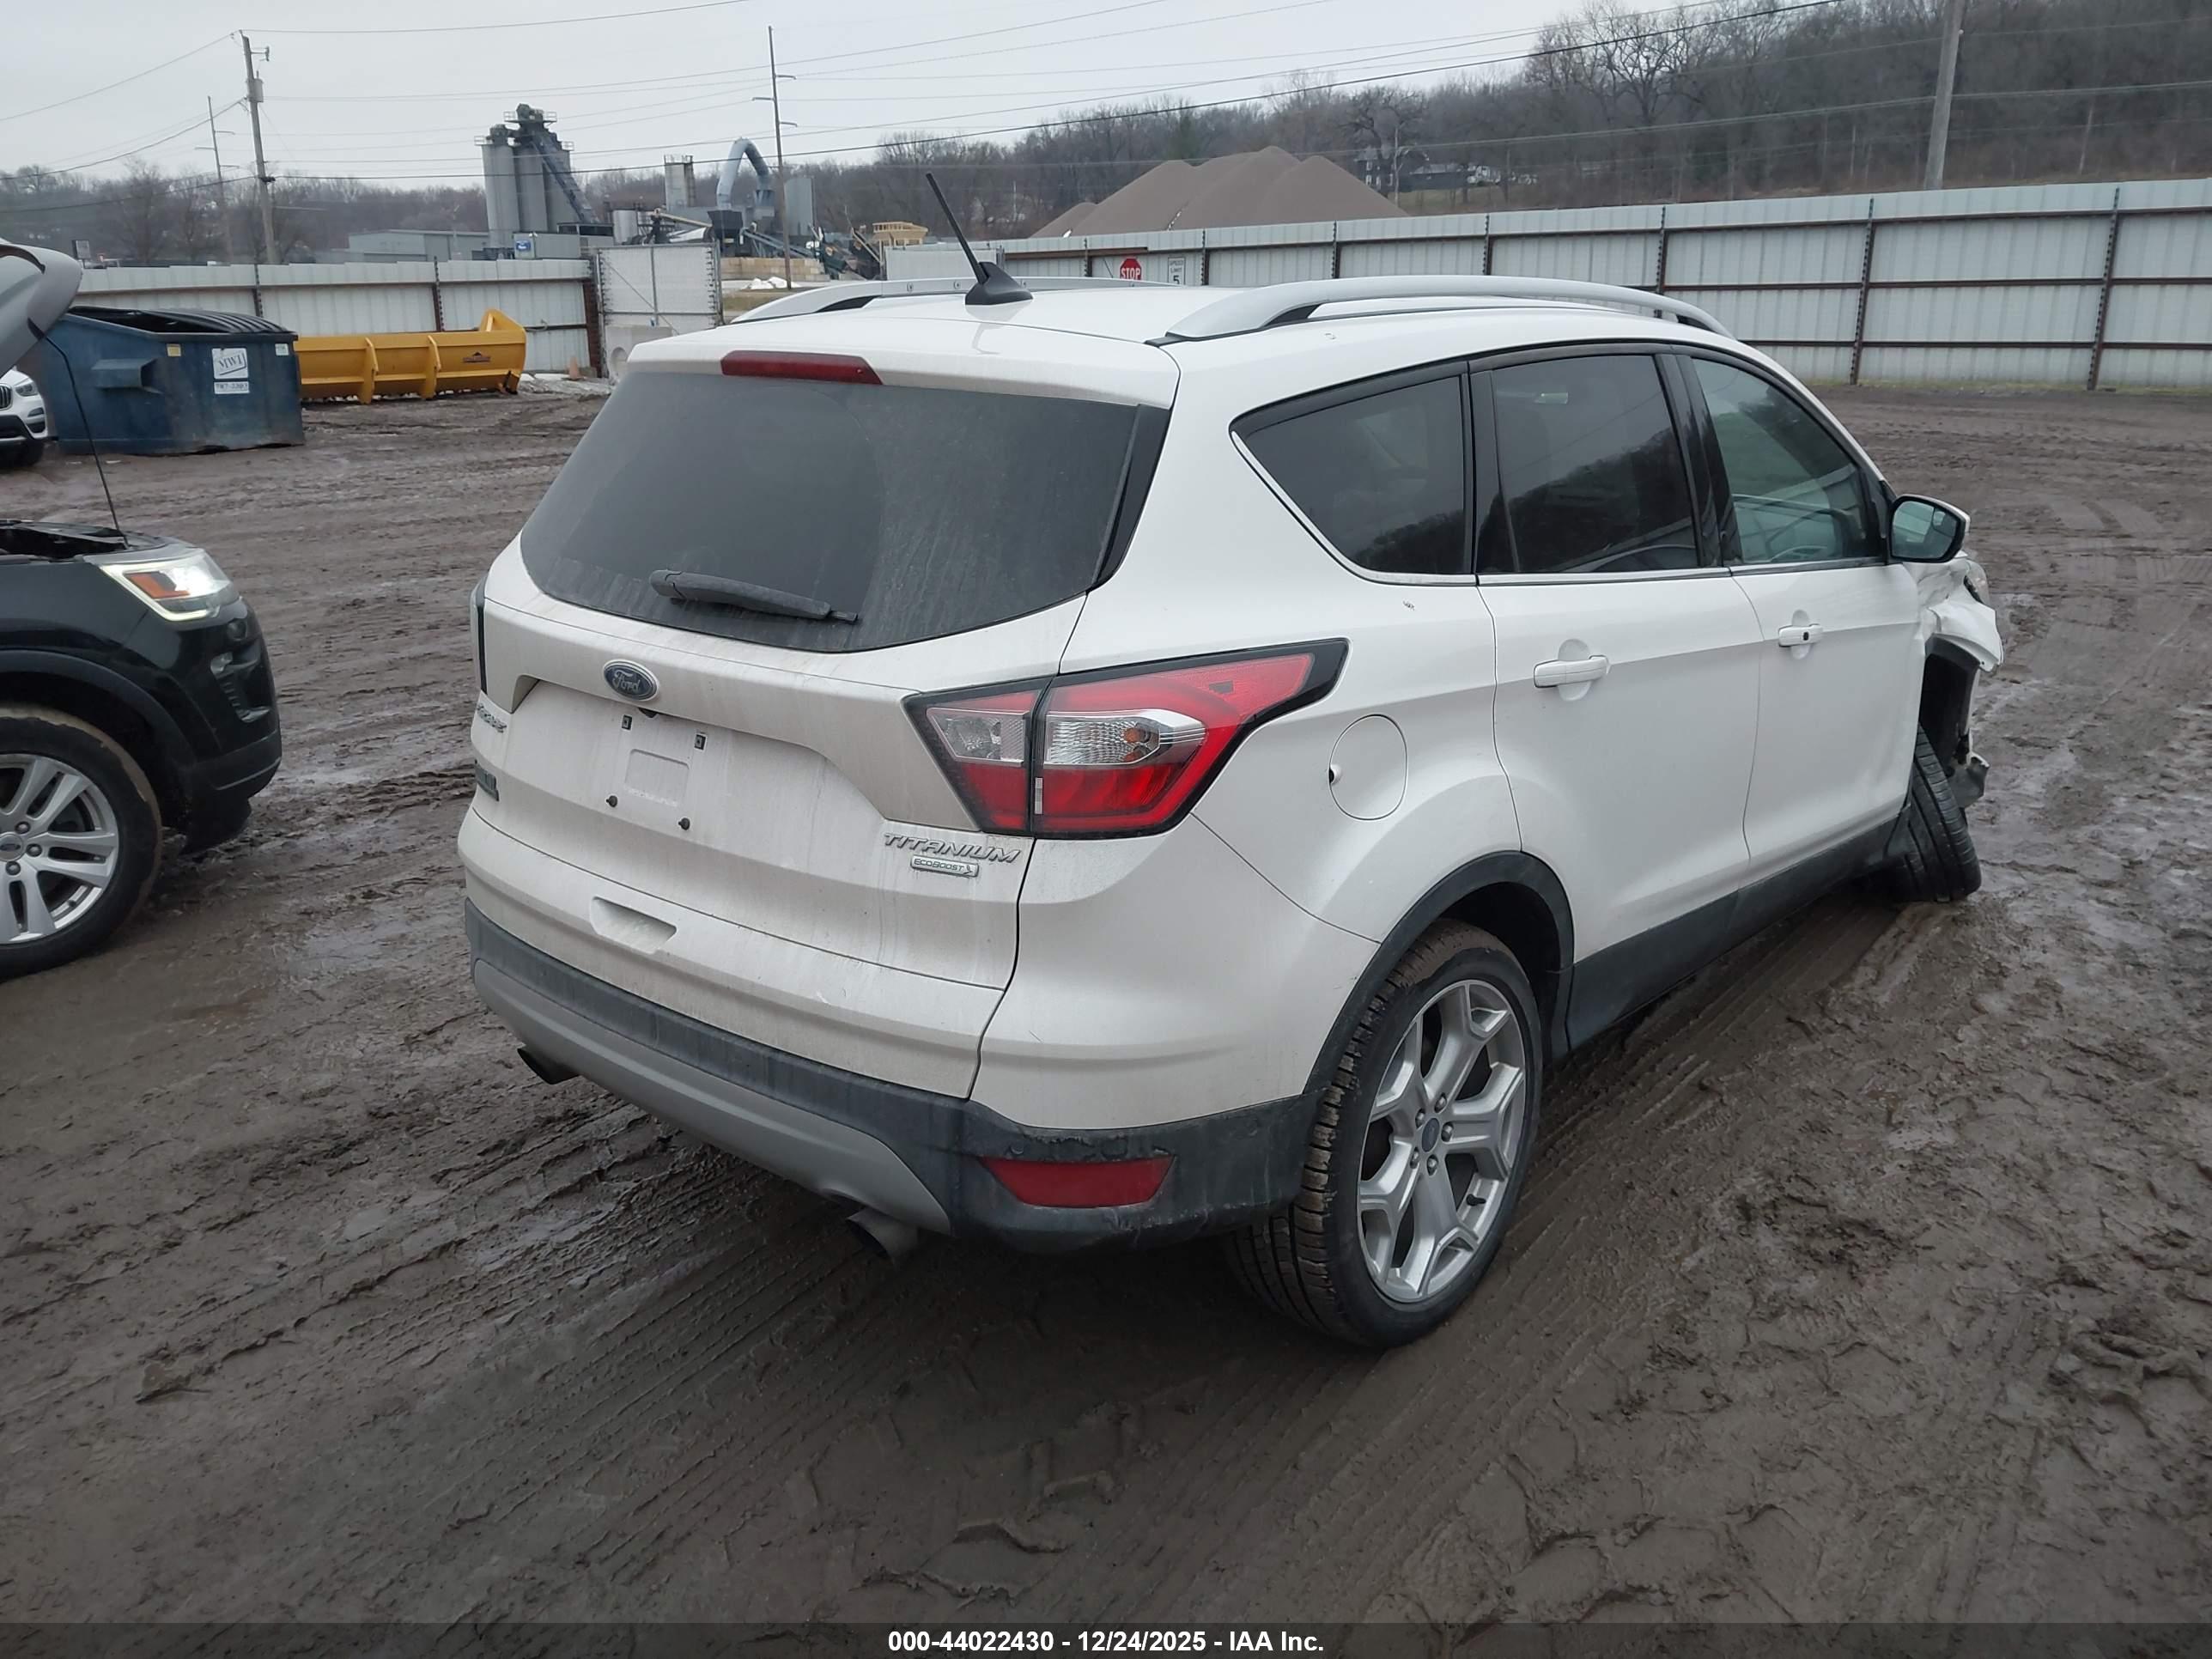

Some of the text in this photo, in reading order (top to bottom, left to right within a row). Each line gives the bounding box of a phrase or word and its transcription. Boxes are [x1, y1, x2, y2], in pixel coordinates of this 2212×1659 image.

[1121, 267, 1141, 279] STOP
[1173, 275, 1180, 284] 5
[611, 670, 641, 692] Ford
[884, 833, 1020, 863] TITANIUM
